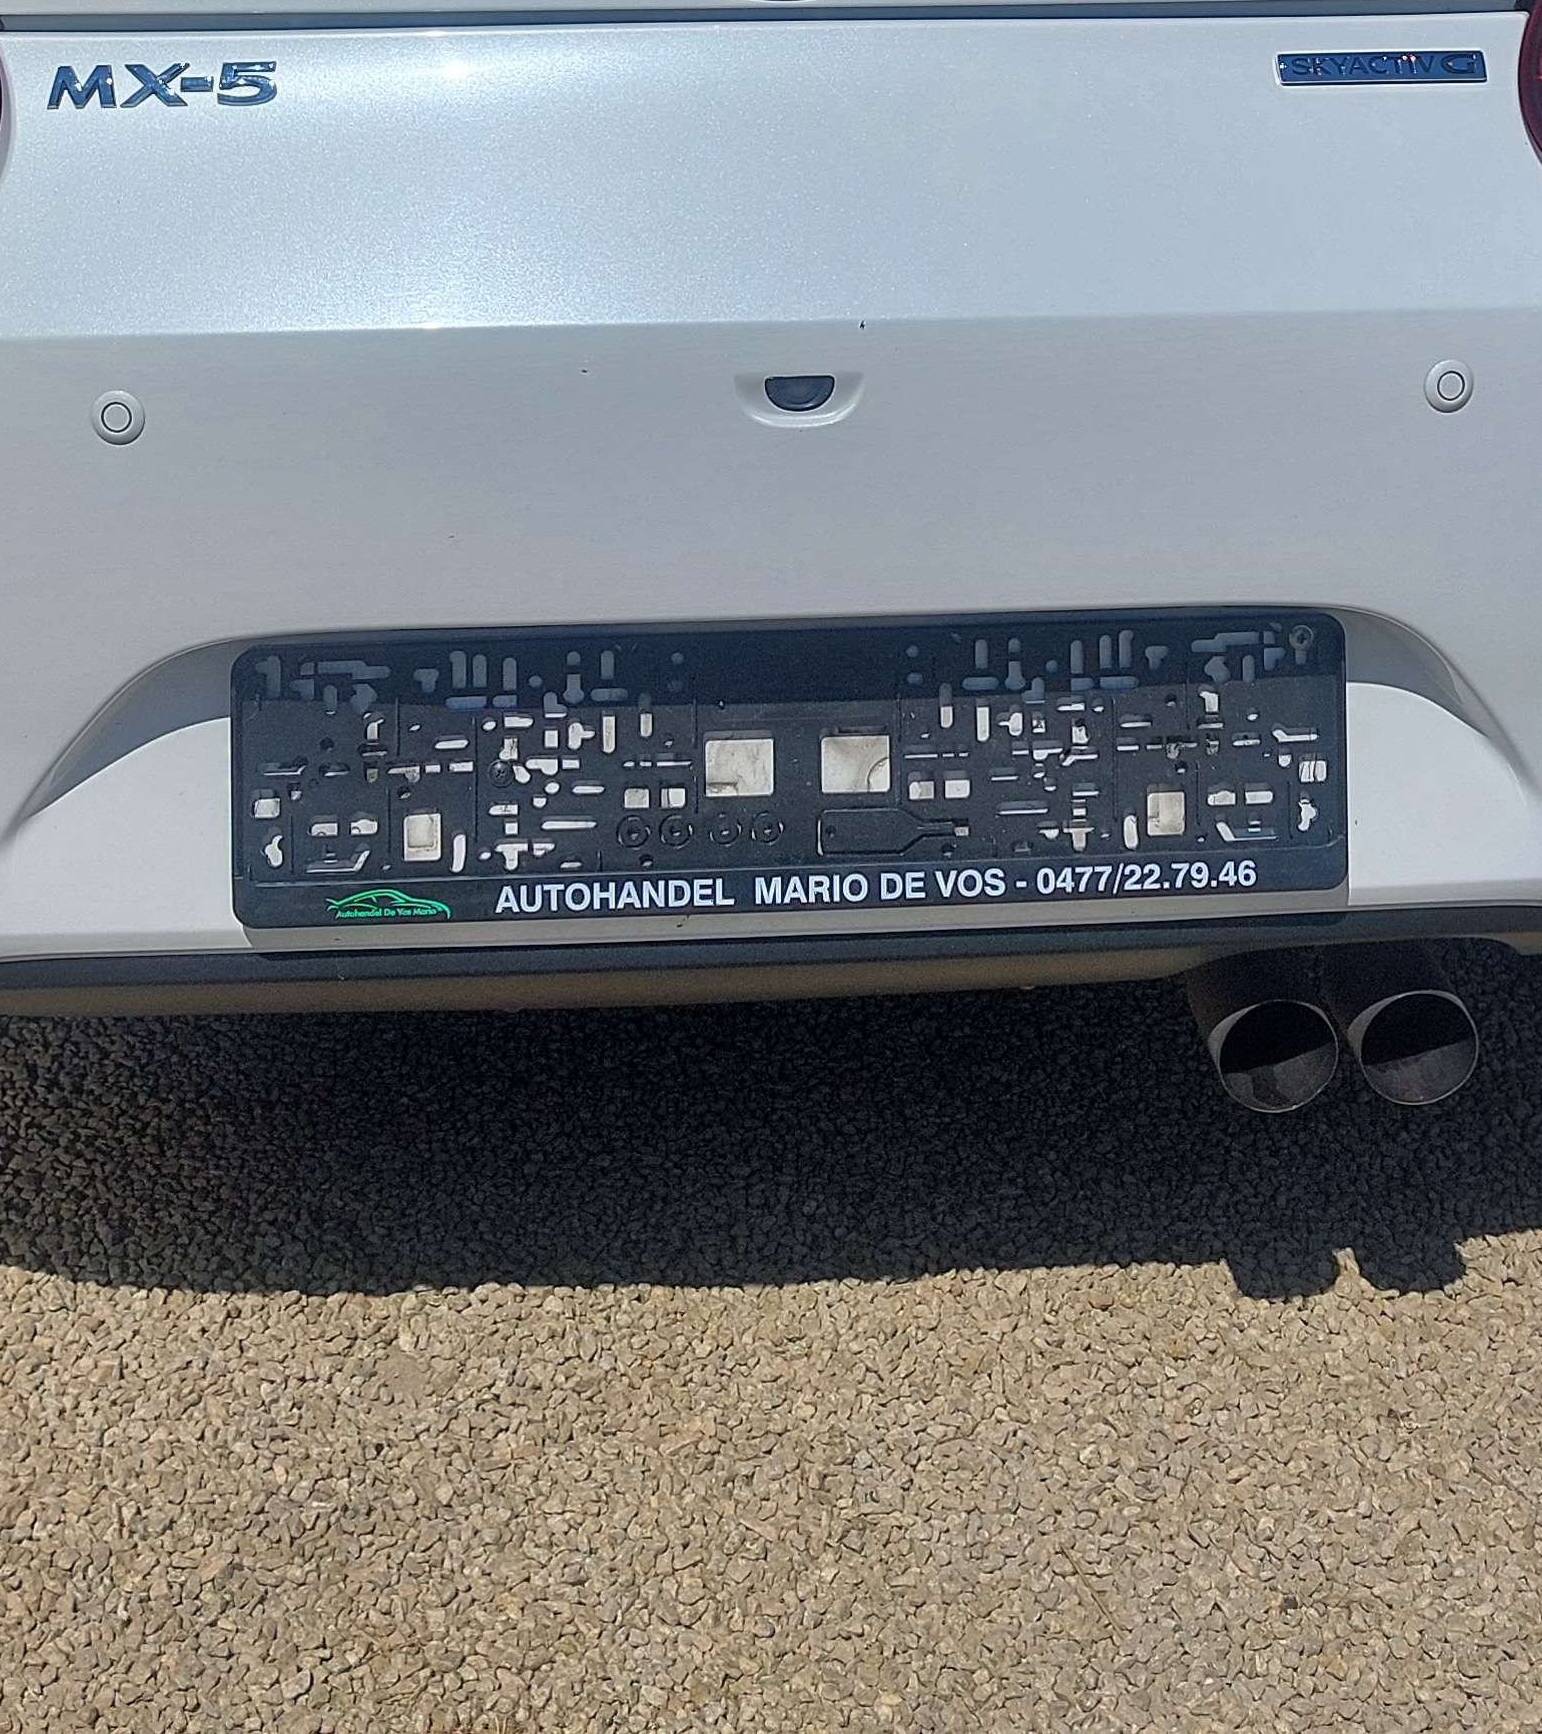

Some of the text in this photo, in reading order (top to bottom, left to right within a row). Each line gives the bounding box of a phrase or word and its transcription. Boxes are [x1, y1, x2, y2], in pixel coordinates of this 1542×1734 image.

[46, 60, 278, 110] MX-5
[494, 877, 735, 914] AUTOHANDEL
[754, 873, 869, 905] MARIO
[880, 871, 926, 900] DE
[934, 868, 1006, 898] VOS
[1036, 859, 1257, 895] 0477/22.79.46
